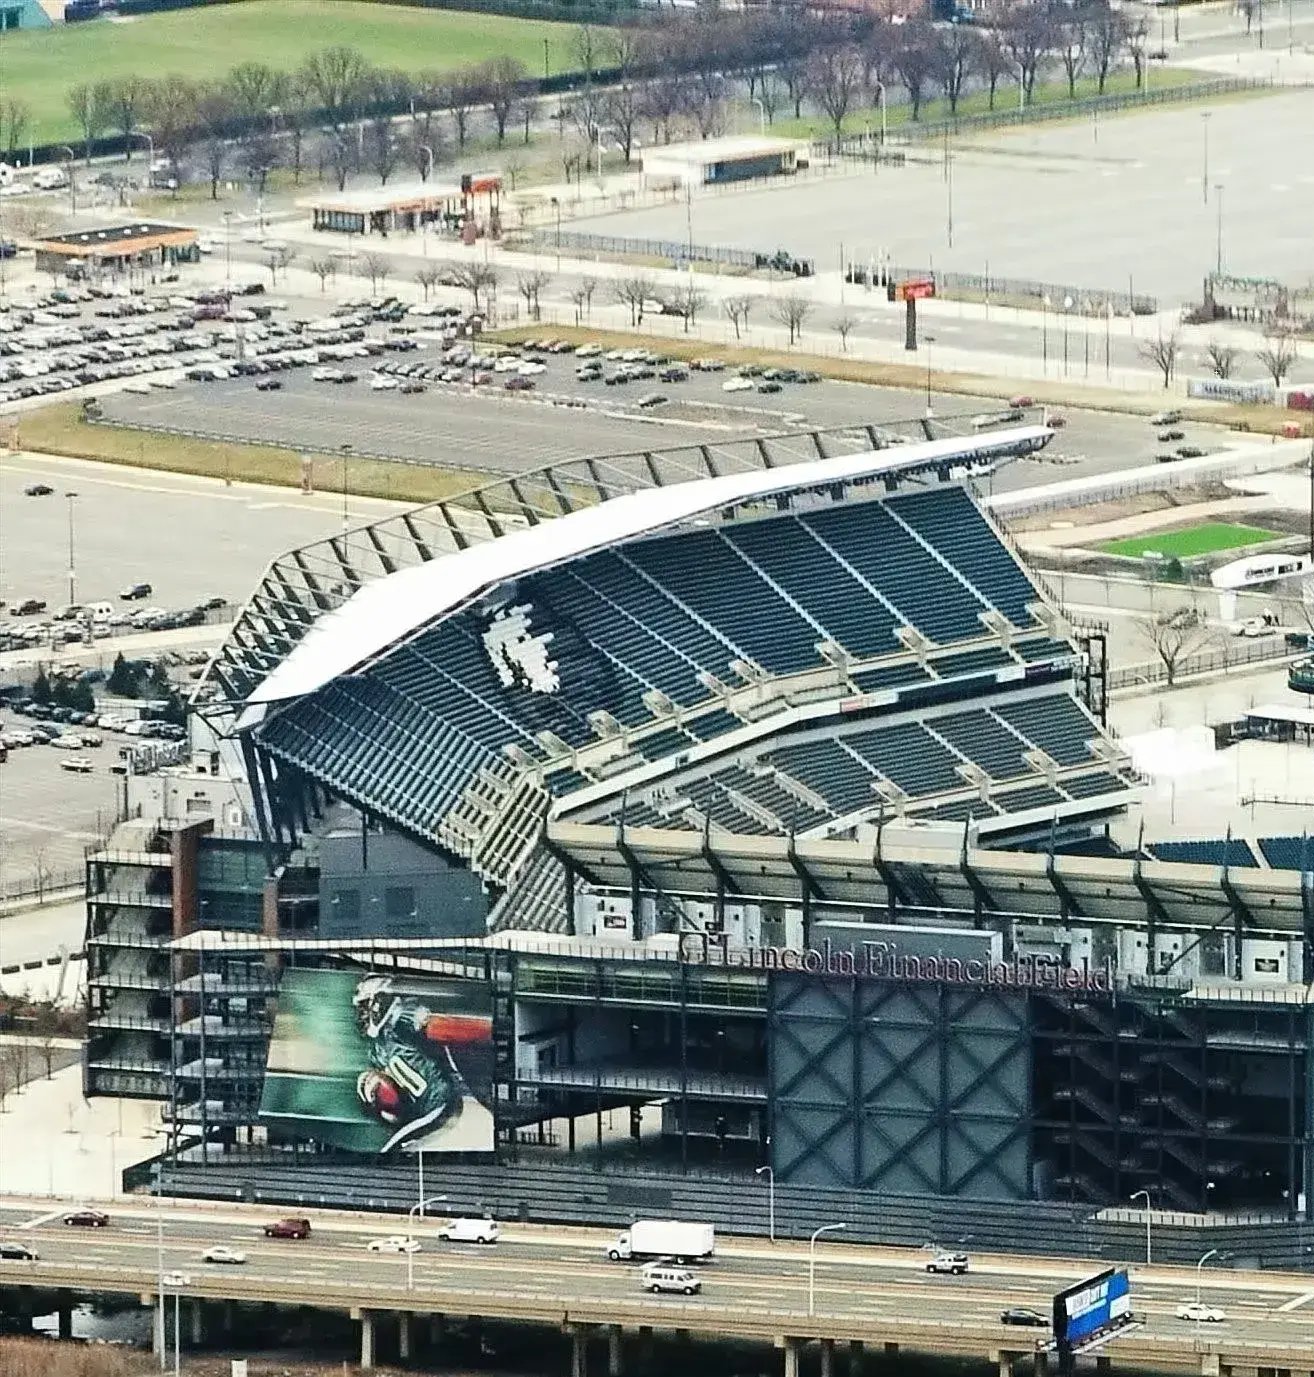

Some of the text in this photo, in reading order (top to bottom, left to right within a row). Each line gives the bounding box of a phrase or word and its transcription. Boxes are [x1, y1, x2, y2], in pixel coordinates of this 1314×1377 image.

[719, 932, 1113, 991] Lincoln Financial Field
